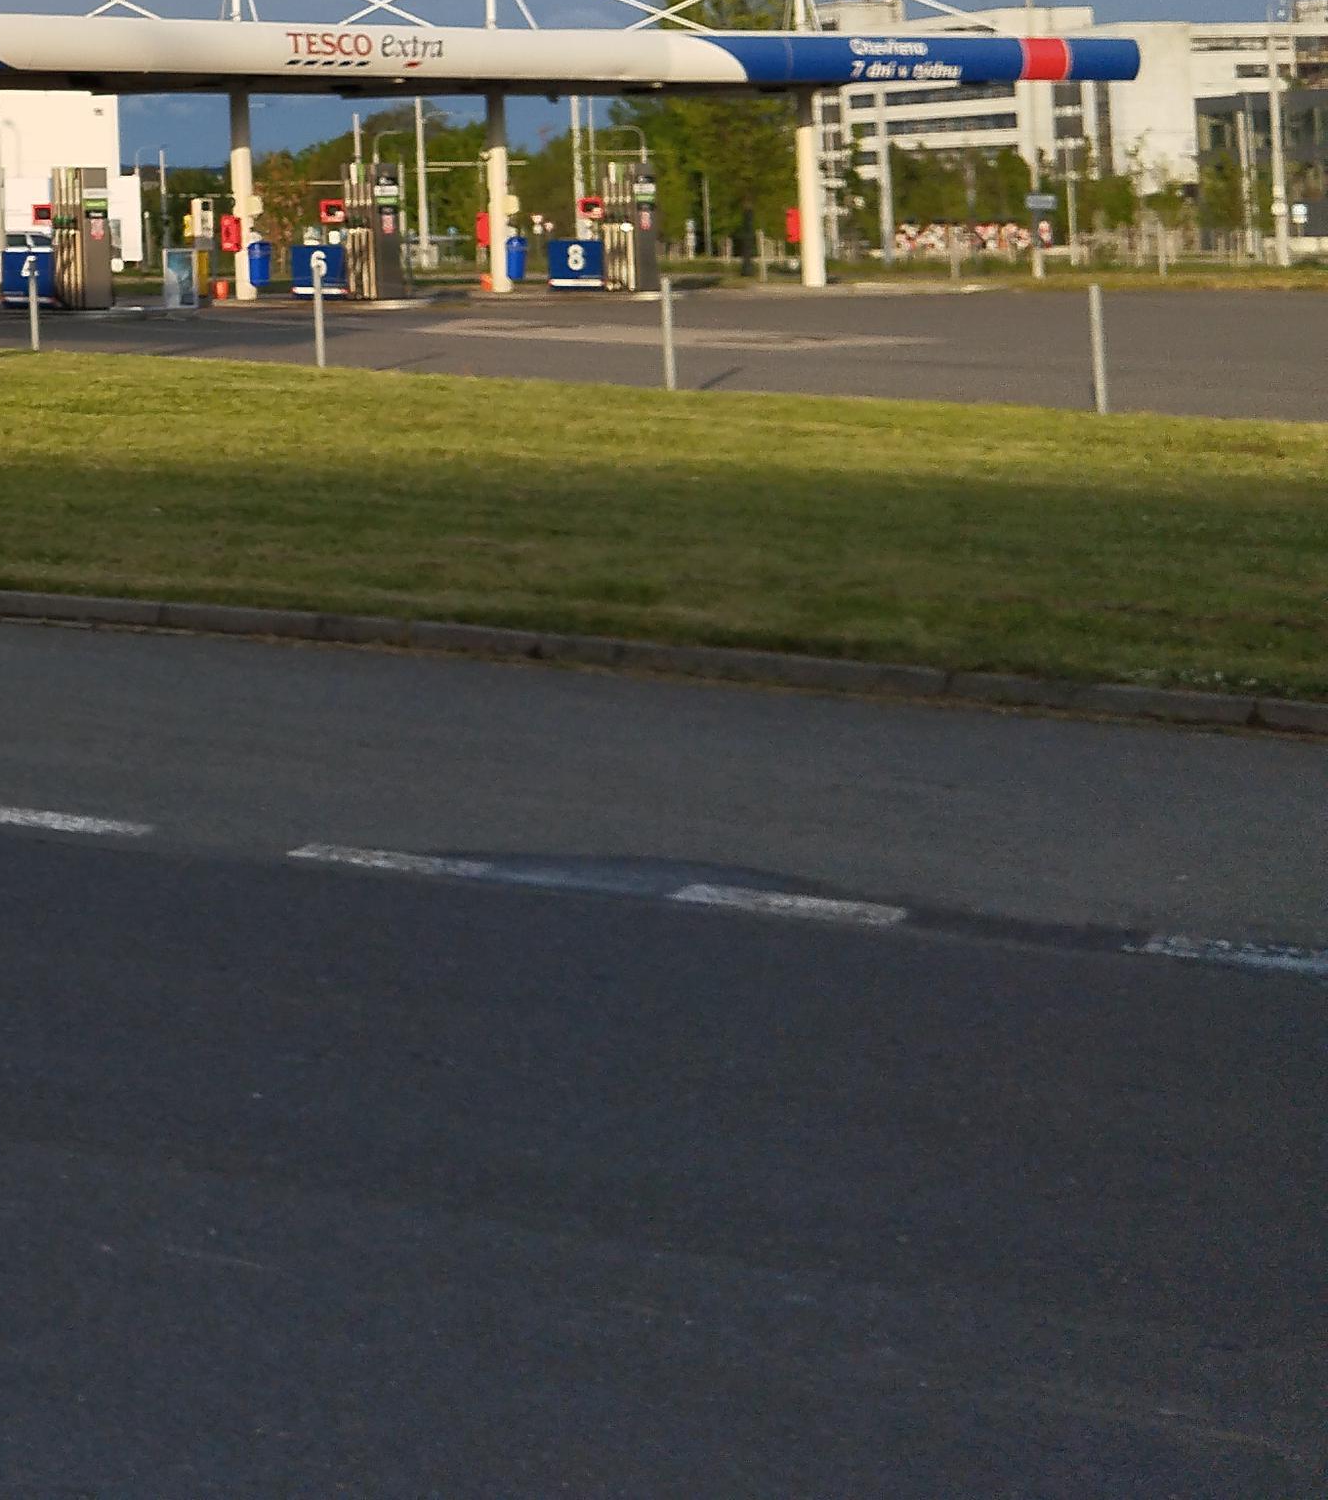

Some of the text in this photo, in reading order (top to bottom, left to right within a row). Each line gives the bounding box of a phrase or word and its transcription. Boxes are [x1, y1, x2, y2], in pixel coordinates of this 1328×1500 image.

[286, 32, 444, 58] TESCO extra
[850, 60, 865, 79] 7
[310, 250, 328, 277] 6
[567, 243, 585, 271] 8
